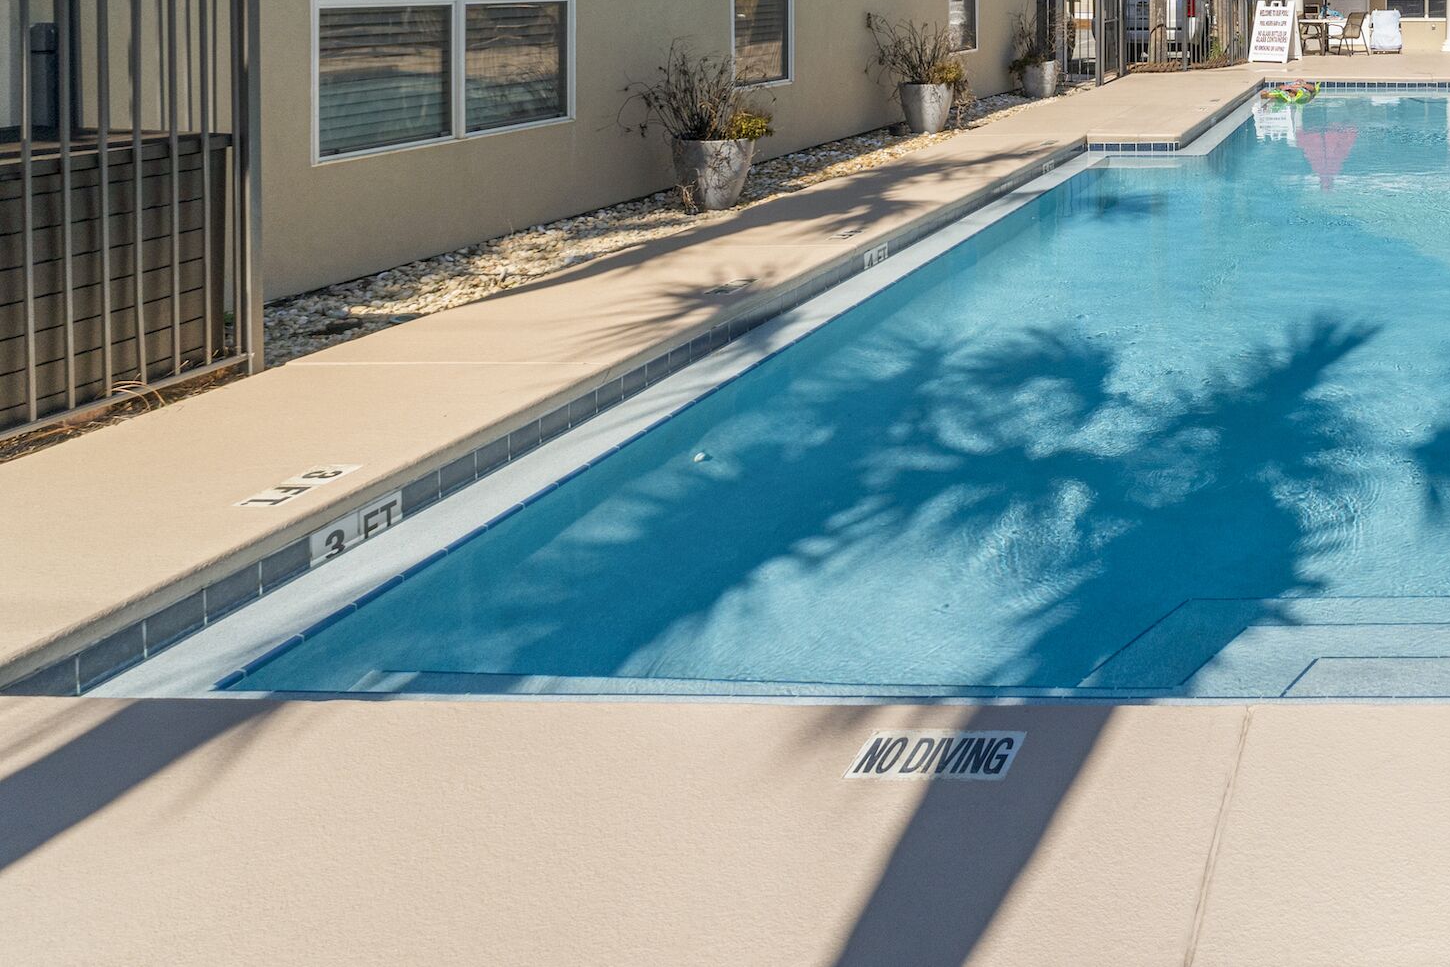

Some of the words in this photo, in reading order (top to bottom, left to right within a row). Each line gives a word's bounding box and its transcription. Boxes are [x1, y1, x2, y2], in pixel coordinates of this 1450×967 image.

[301, 470, 343, 480] 3
[240, 485, 312, 506] FT
[325, 529, 346, 559] 3
[362, 499, 398, 540] FT
[852, 737, 909, 775] NO
[898, 737, 1015, 775] DIVING
